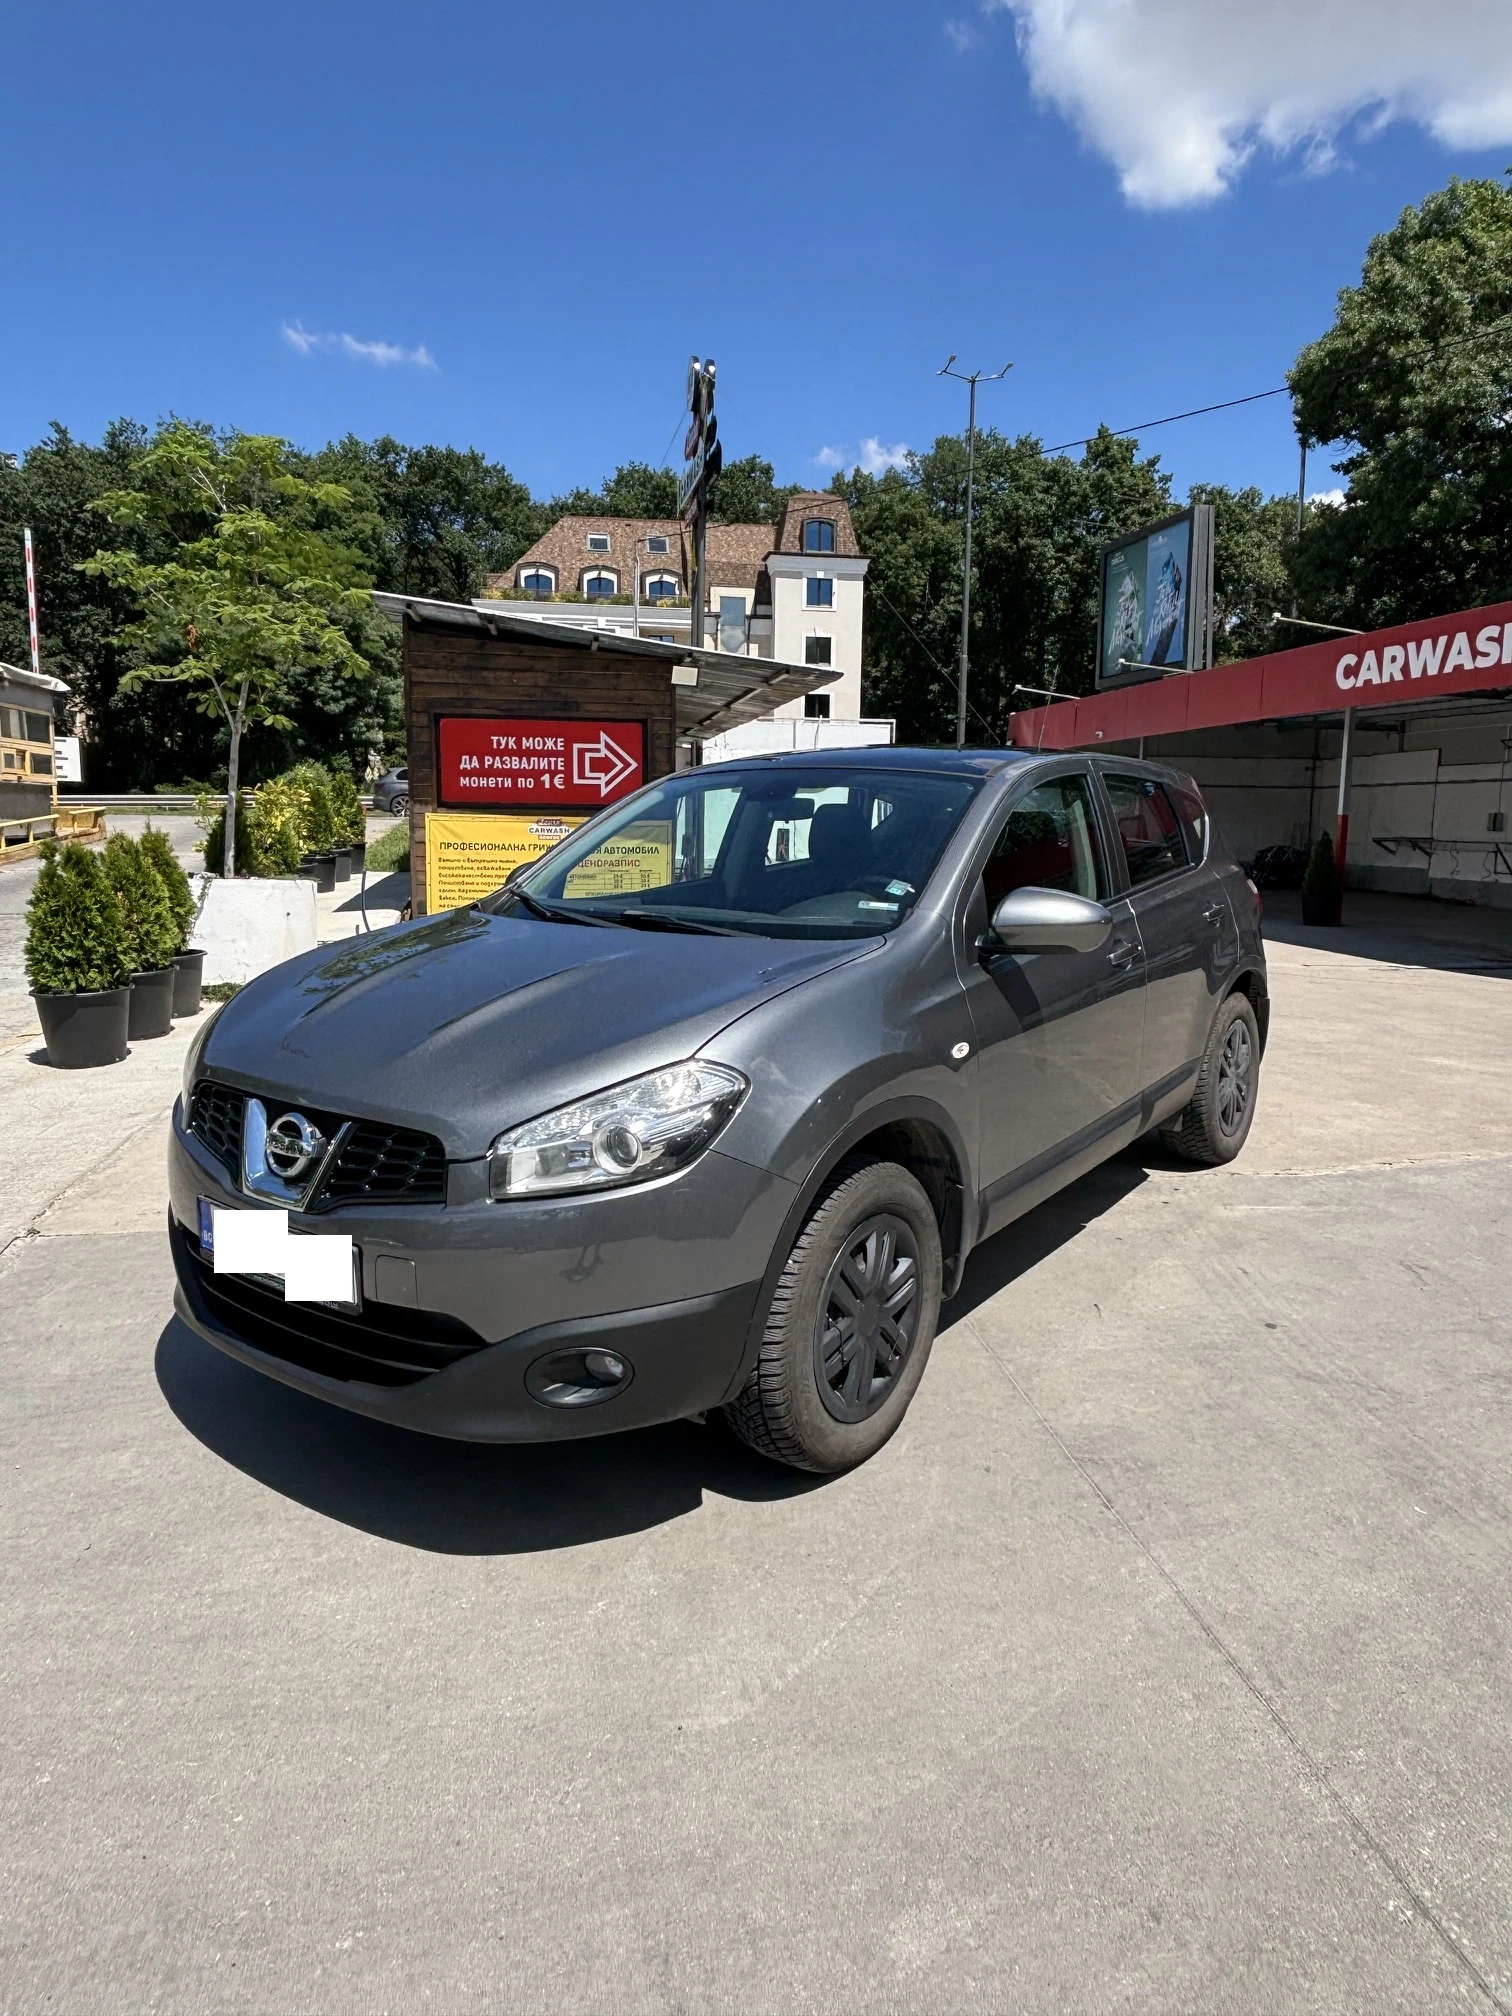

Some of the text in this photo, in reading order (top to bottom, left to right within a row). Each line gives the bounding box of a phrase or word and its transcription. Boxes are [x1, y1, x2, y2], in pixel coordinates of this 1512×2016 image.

[491, 736, 565, 751] ТУК МОЖЕ
[459, 756, 565, 771] ДА РАЗВАЛИТЕ
[540, 774, 565, 790] 1€
[439, 842, 526, 851] ПРОФЕСИОНАЛНА
[603, 846, 660, 855] АВТОМОБИЛ
